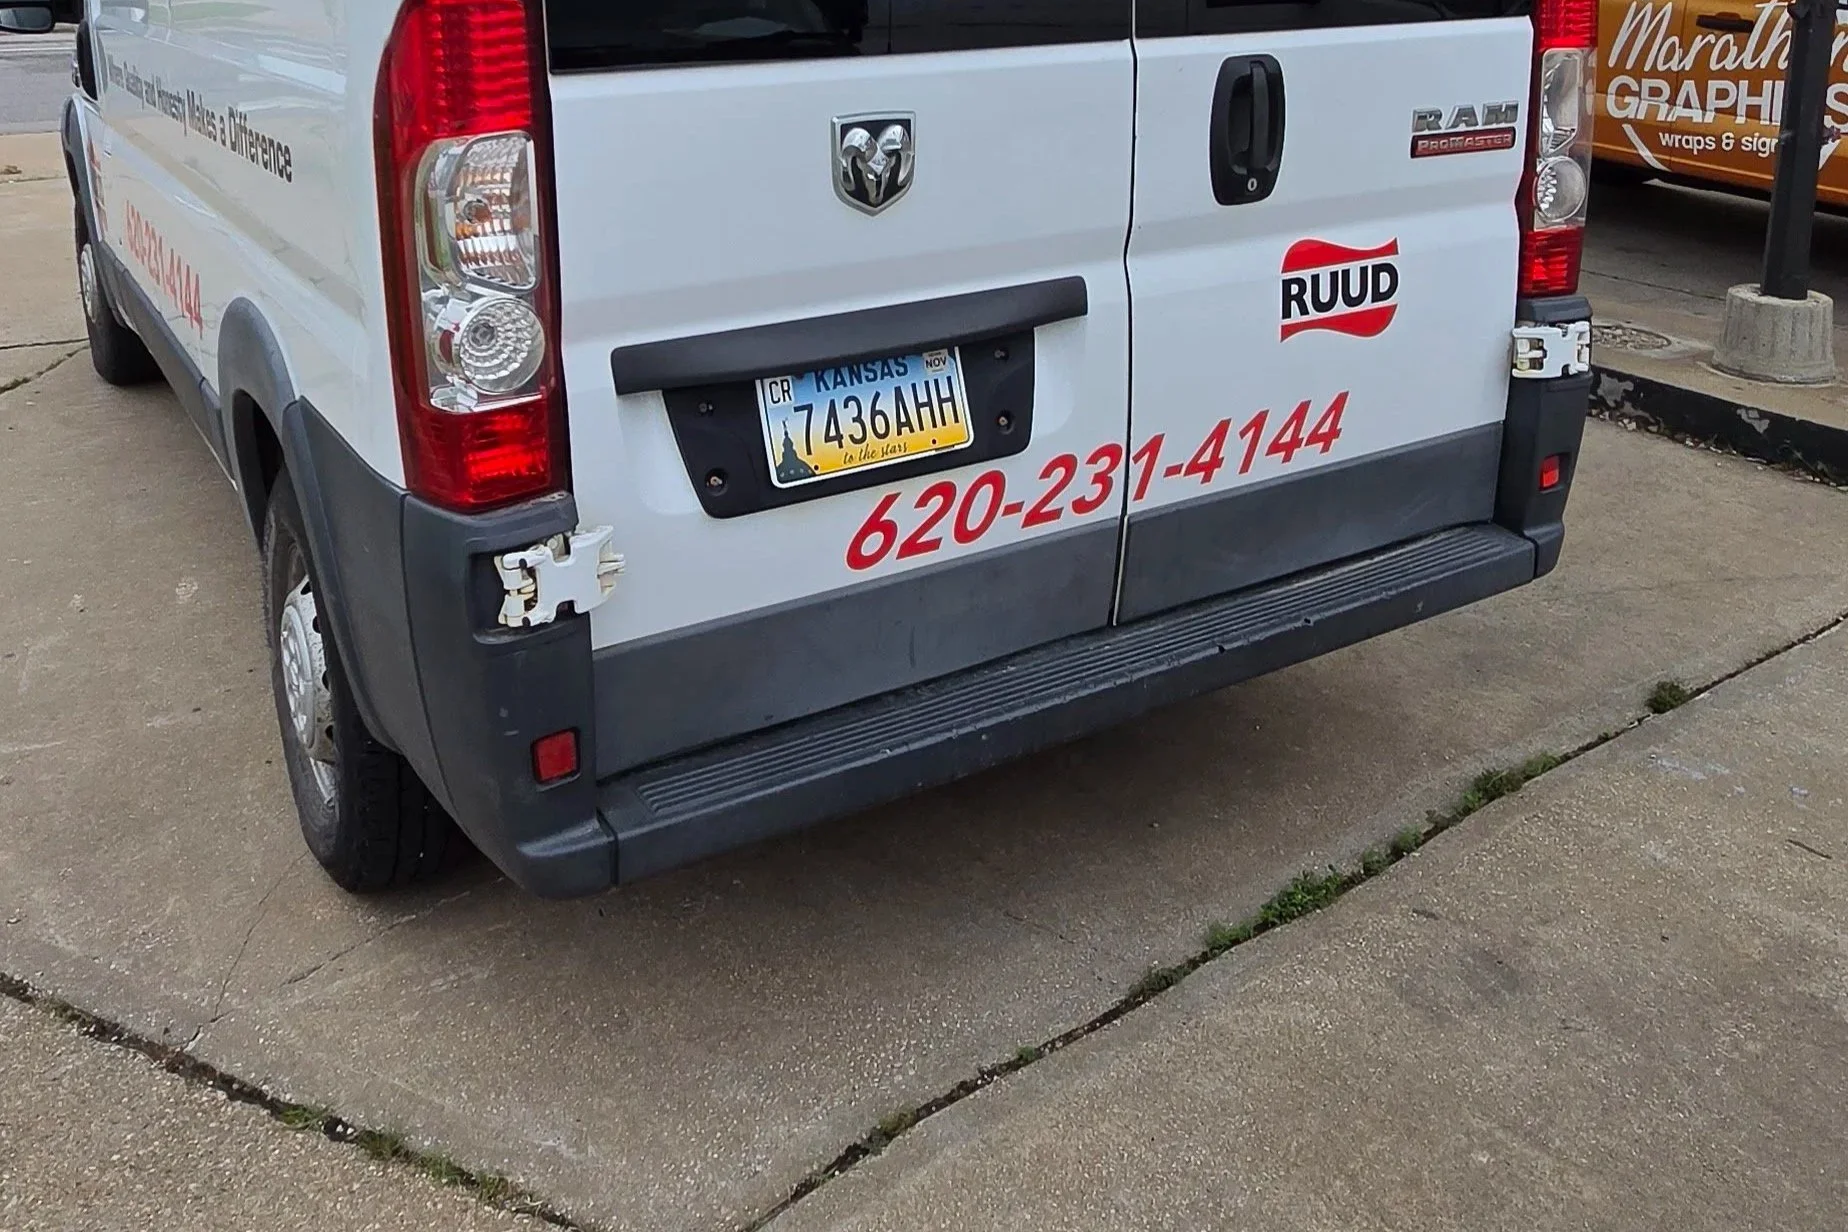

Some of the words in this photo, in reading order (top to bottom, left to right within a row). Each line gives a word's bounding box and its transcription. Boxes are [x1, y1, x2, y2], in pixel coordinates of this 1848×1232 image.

[1412, 101, 1519, 133] RAM
[1606, 74, 1848, 134] GRAPHIS
[186, 88, 217, 142] Makes
[220, 115, 227, 147] a
[228, 104, 292, 184] Difference
[1659, 133, 1716, 155] wraps
[1721, 132, 1734, 152] &
[1281, 262, 1399, 320] RUUD
[769, 378, 792, 405] CR
[814, 356, 909, 393] KANSAS
[925, 356, 947, 368] NOV
[793, 375, 960, 456] 7436AHH
[843, 451, 854, 465] to
[858, 443, 877, 460] the
[881, 440, 908, 458] stars
[845, 390, 1350, 571] 620-231-4144
